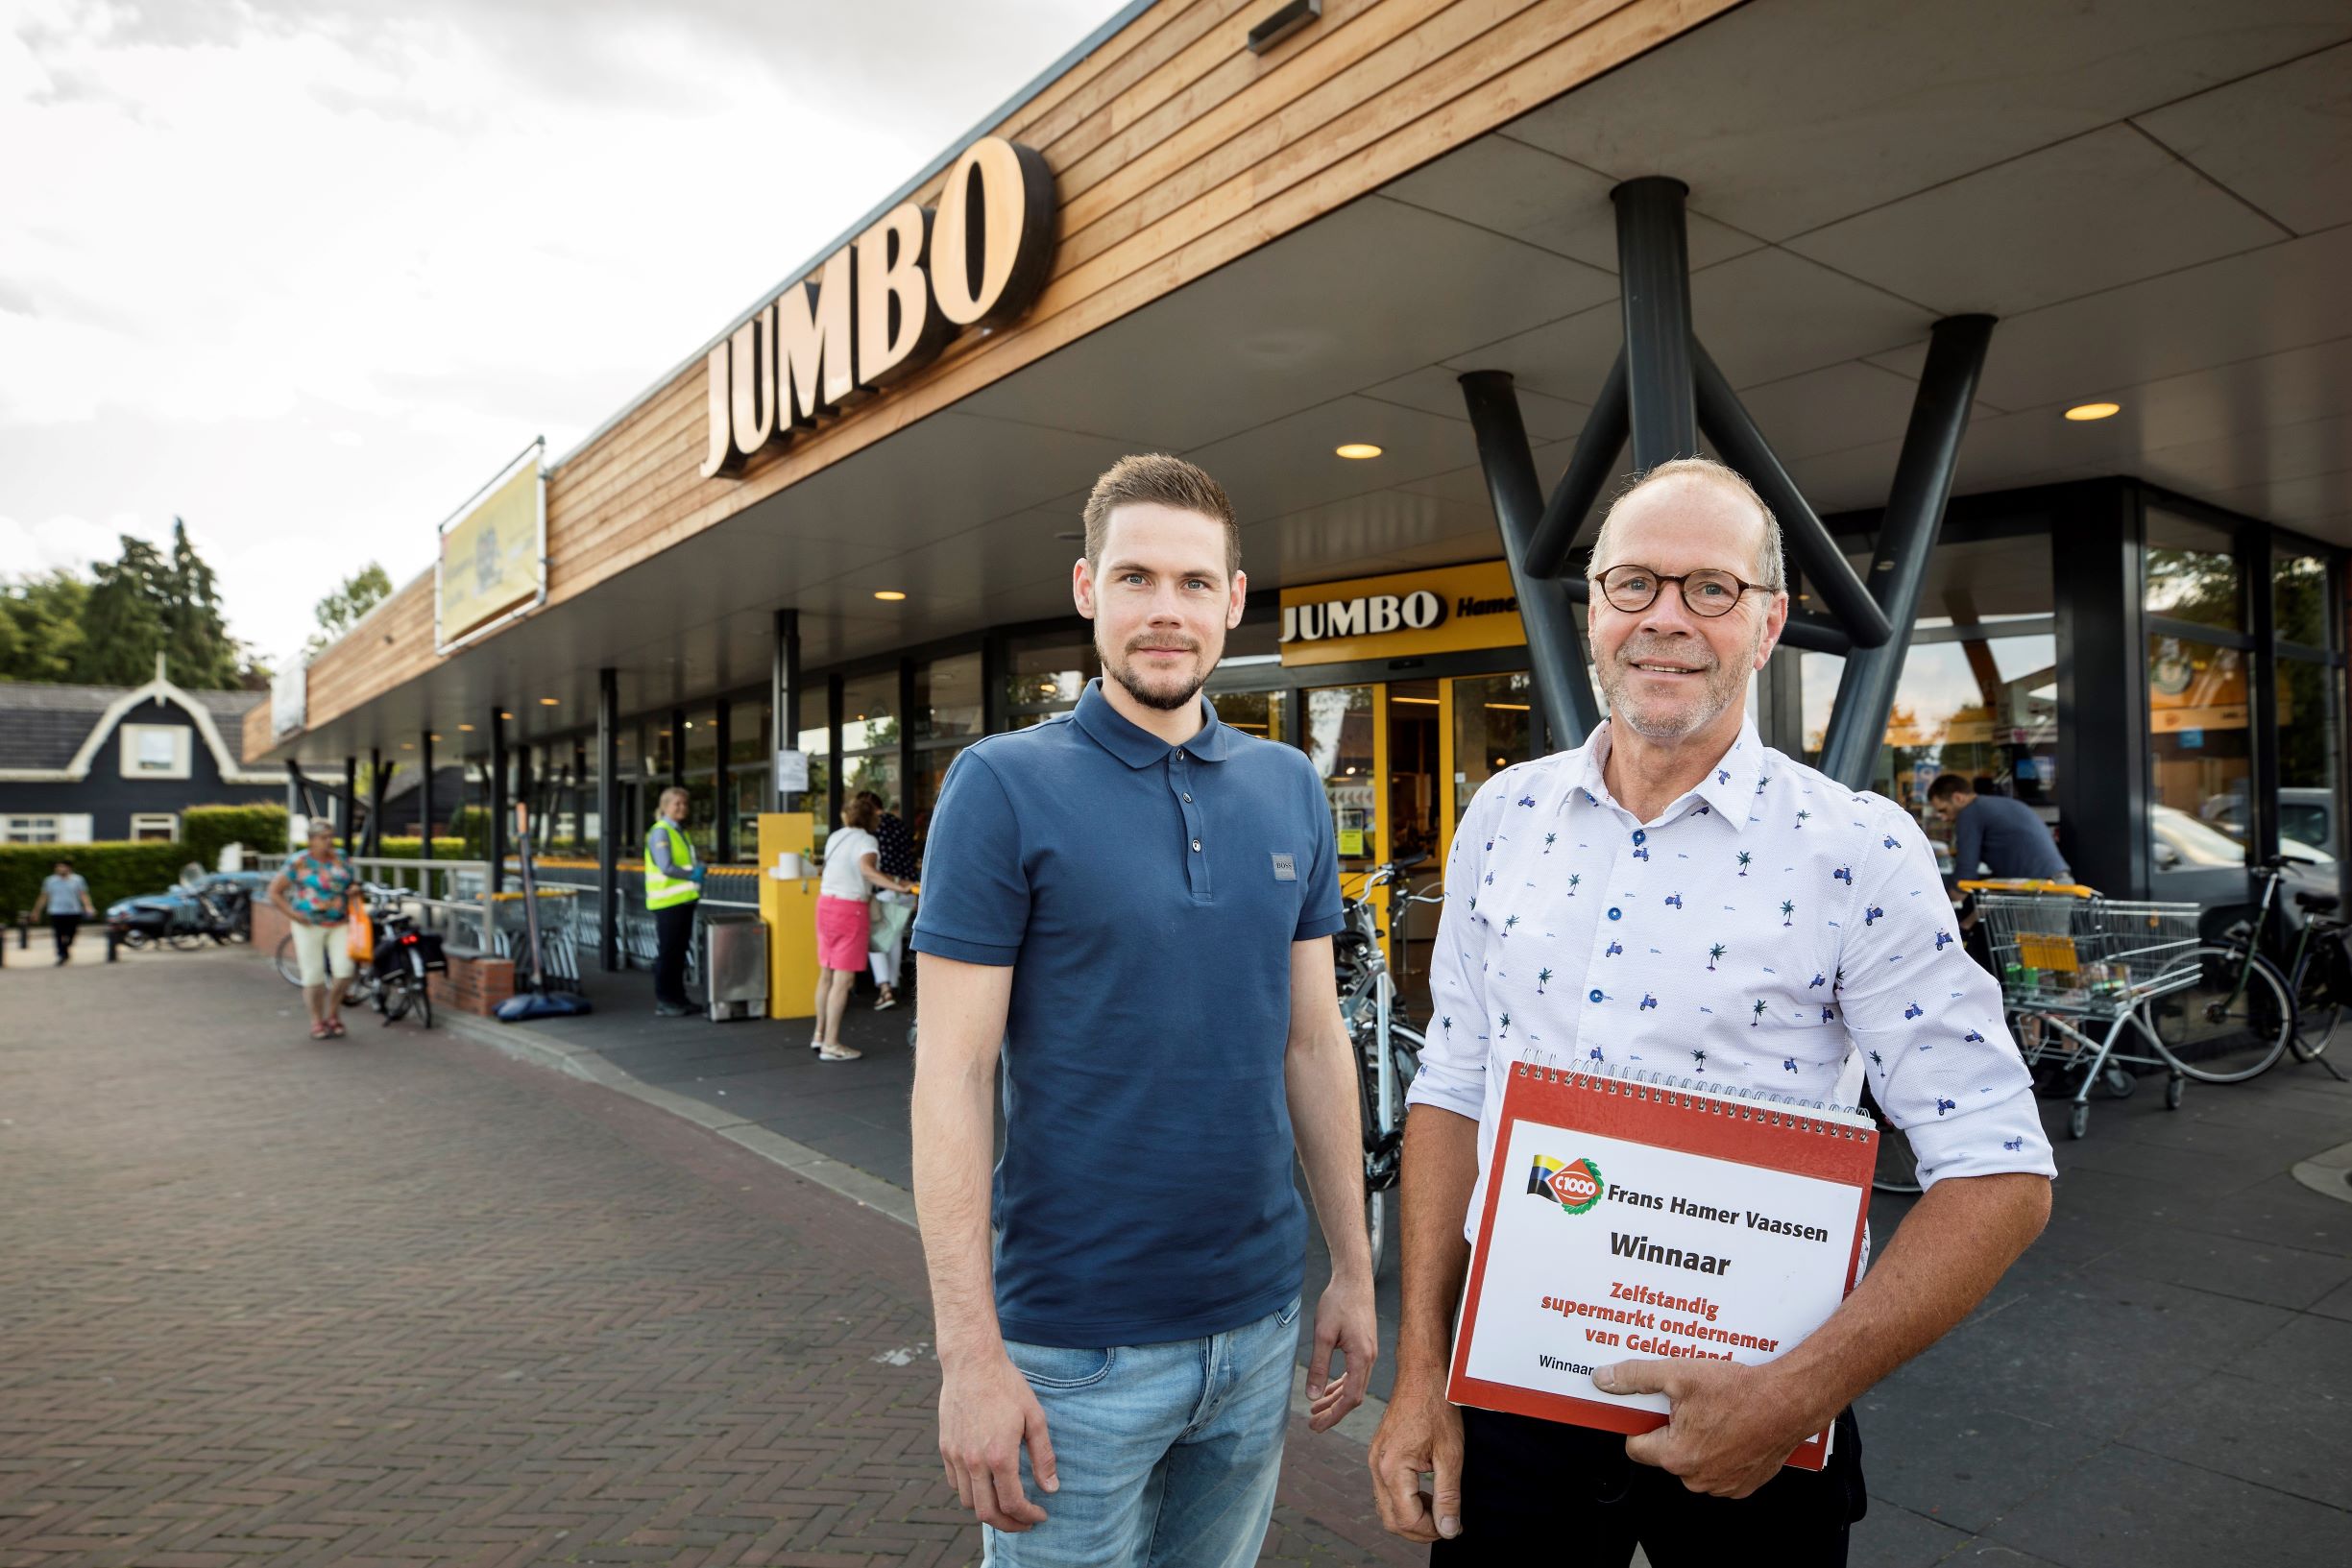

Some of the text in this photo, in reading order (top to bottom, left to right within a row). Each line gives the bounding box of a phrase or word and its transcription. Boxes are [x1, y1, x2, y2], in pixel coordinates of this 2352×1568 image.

[699, 136, 1026, 479] JUMBO
[1278, 591, 1520, 643] JUMBO Hame
[1555, 1175, 1596, 1195] C1000
[1608, 1184, 1829, 1243] Frans Hamer Vaassen
[1610, 1232, 1732, 1276] Winnaar
[1540, 1295, 1779, 1353] supermarkt ondernemer
[1610, 1282, 1719, 1322] Zelfstandig
[1585, 1328, 1620, 1347] van
[1539, 1354, 1594, 1376] Winnaar
